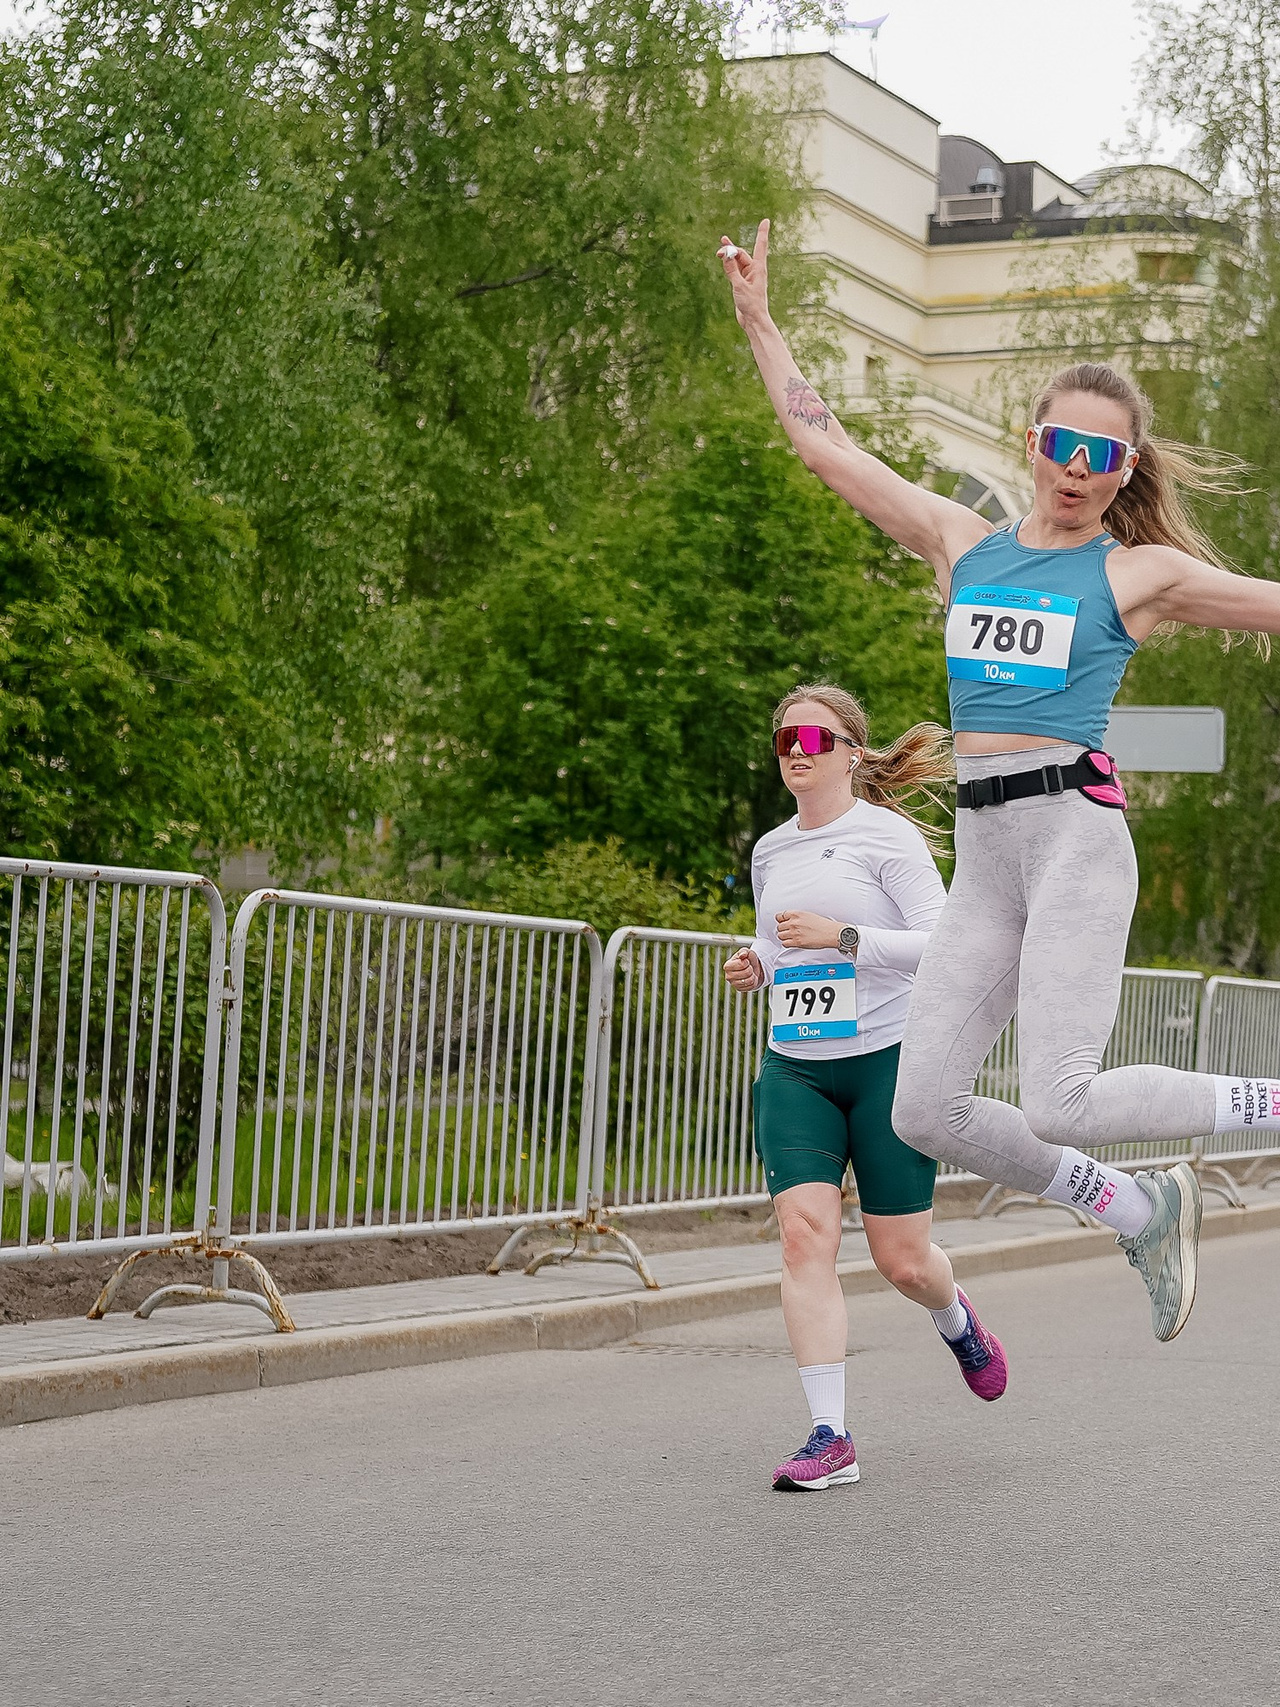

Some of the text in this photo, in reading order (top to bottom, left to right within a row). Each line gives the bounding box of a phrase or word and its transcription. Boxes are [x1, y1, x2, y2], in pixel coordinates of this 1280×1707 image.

[970, 613, 1045, 656] 780
[785, 986, 836, 1017] 799
[1231, 1086, 1241, 1113] ЭТА
[1256, 1081, 1268, 1119] МОЖЕТ
[1066, 1164, 1083, 1189] ЭТА
[1070, 1160, 1096, 1204] ДЕВОЧКА
[1082, 1169, 1107, 1207] МОЖЕТ
